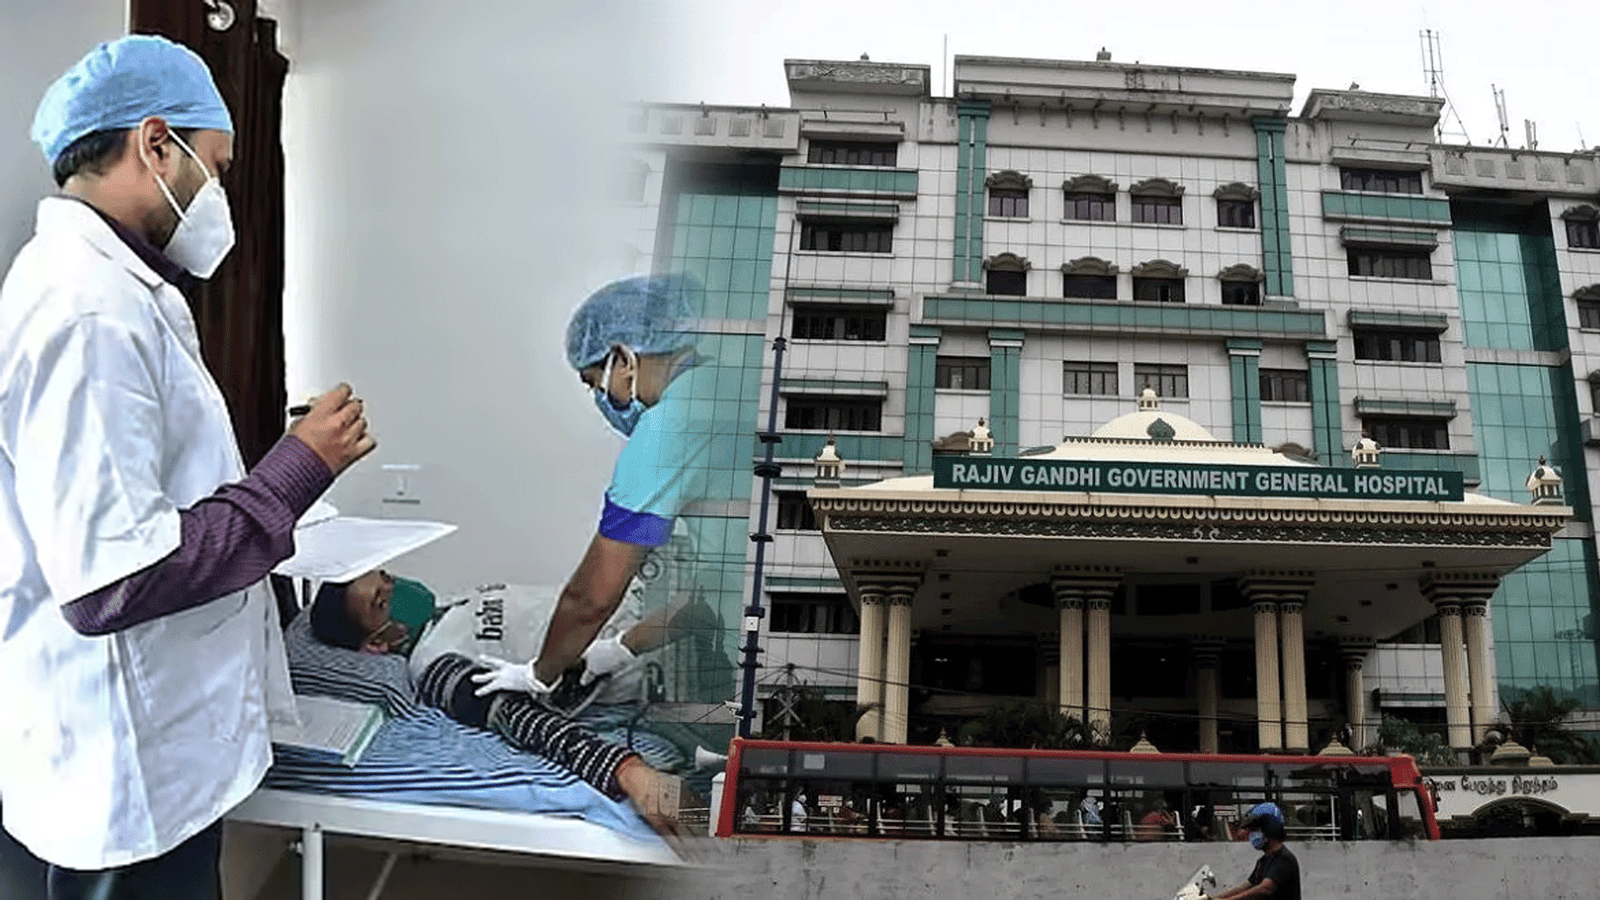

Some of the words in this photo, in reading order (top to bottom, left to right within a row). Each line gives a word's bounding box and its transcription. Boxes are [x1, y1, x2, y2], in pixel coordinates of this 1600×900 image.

[952, 463, 1015, 485] RAJIV
[1020, 465, 1101, 487] GANDHI
[1107, 467, 1250, 490] GOVERNMENT
[1255, 472, 1349, 493] GENERAL
[1354, 474, 1450, 495] HOSPITAL
